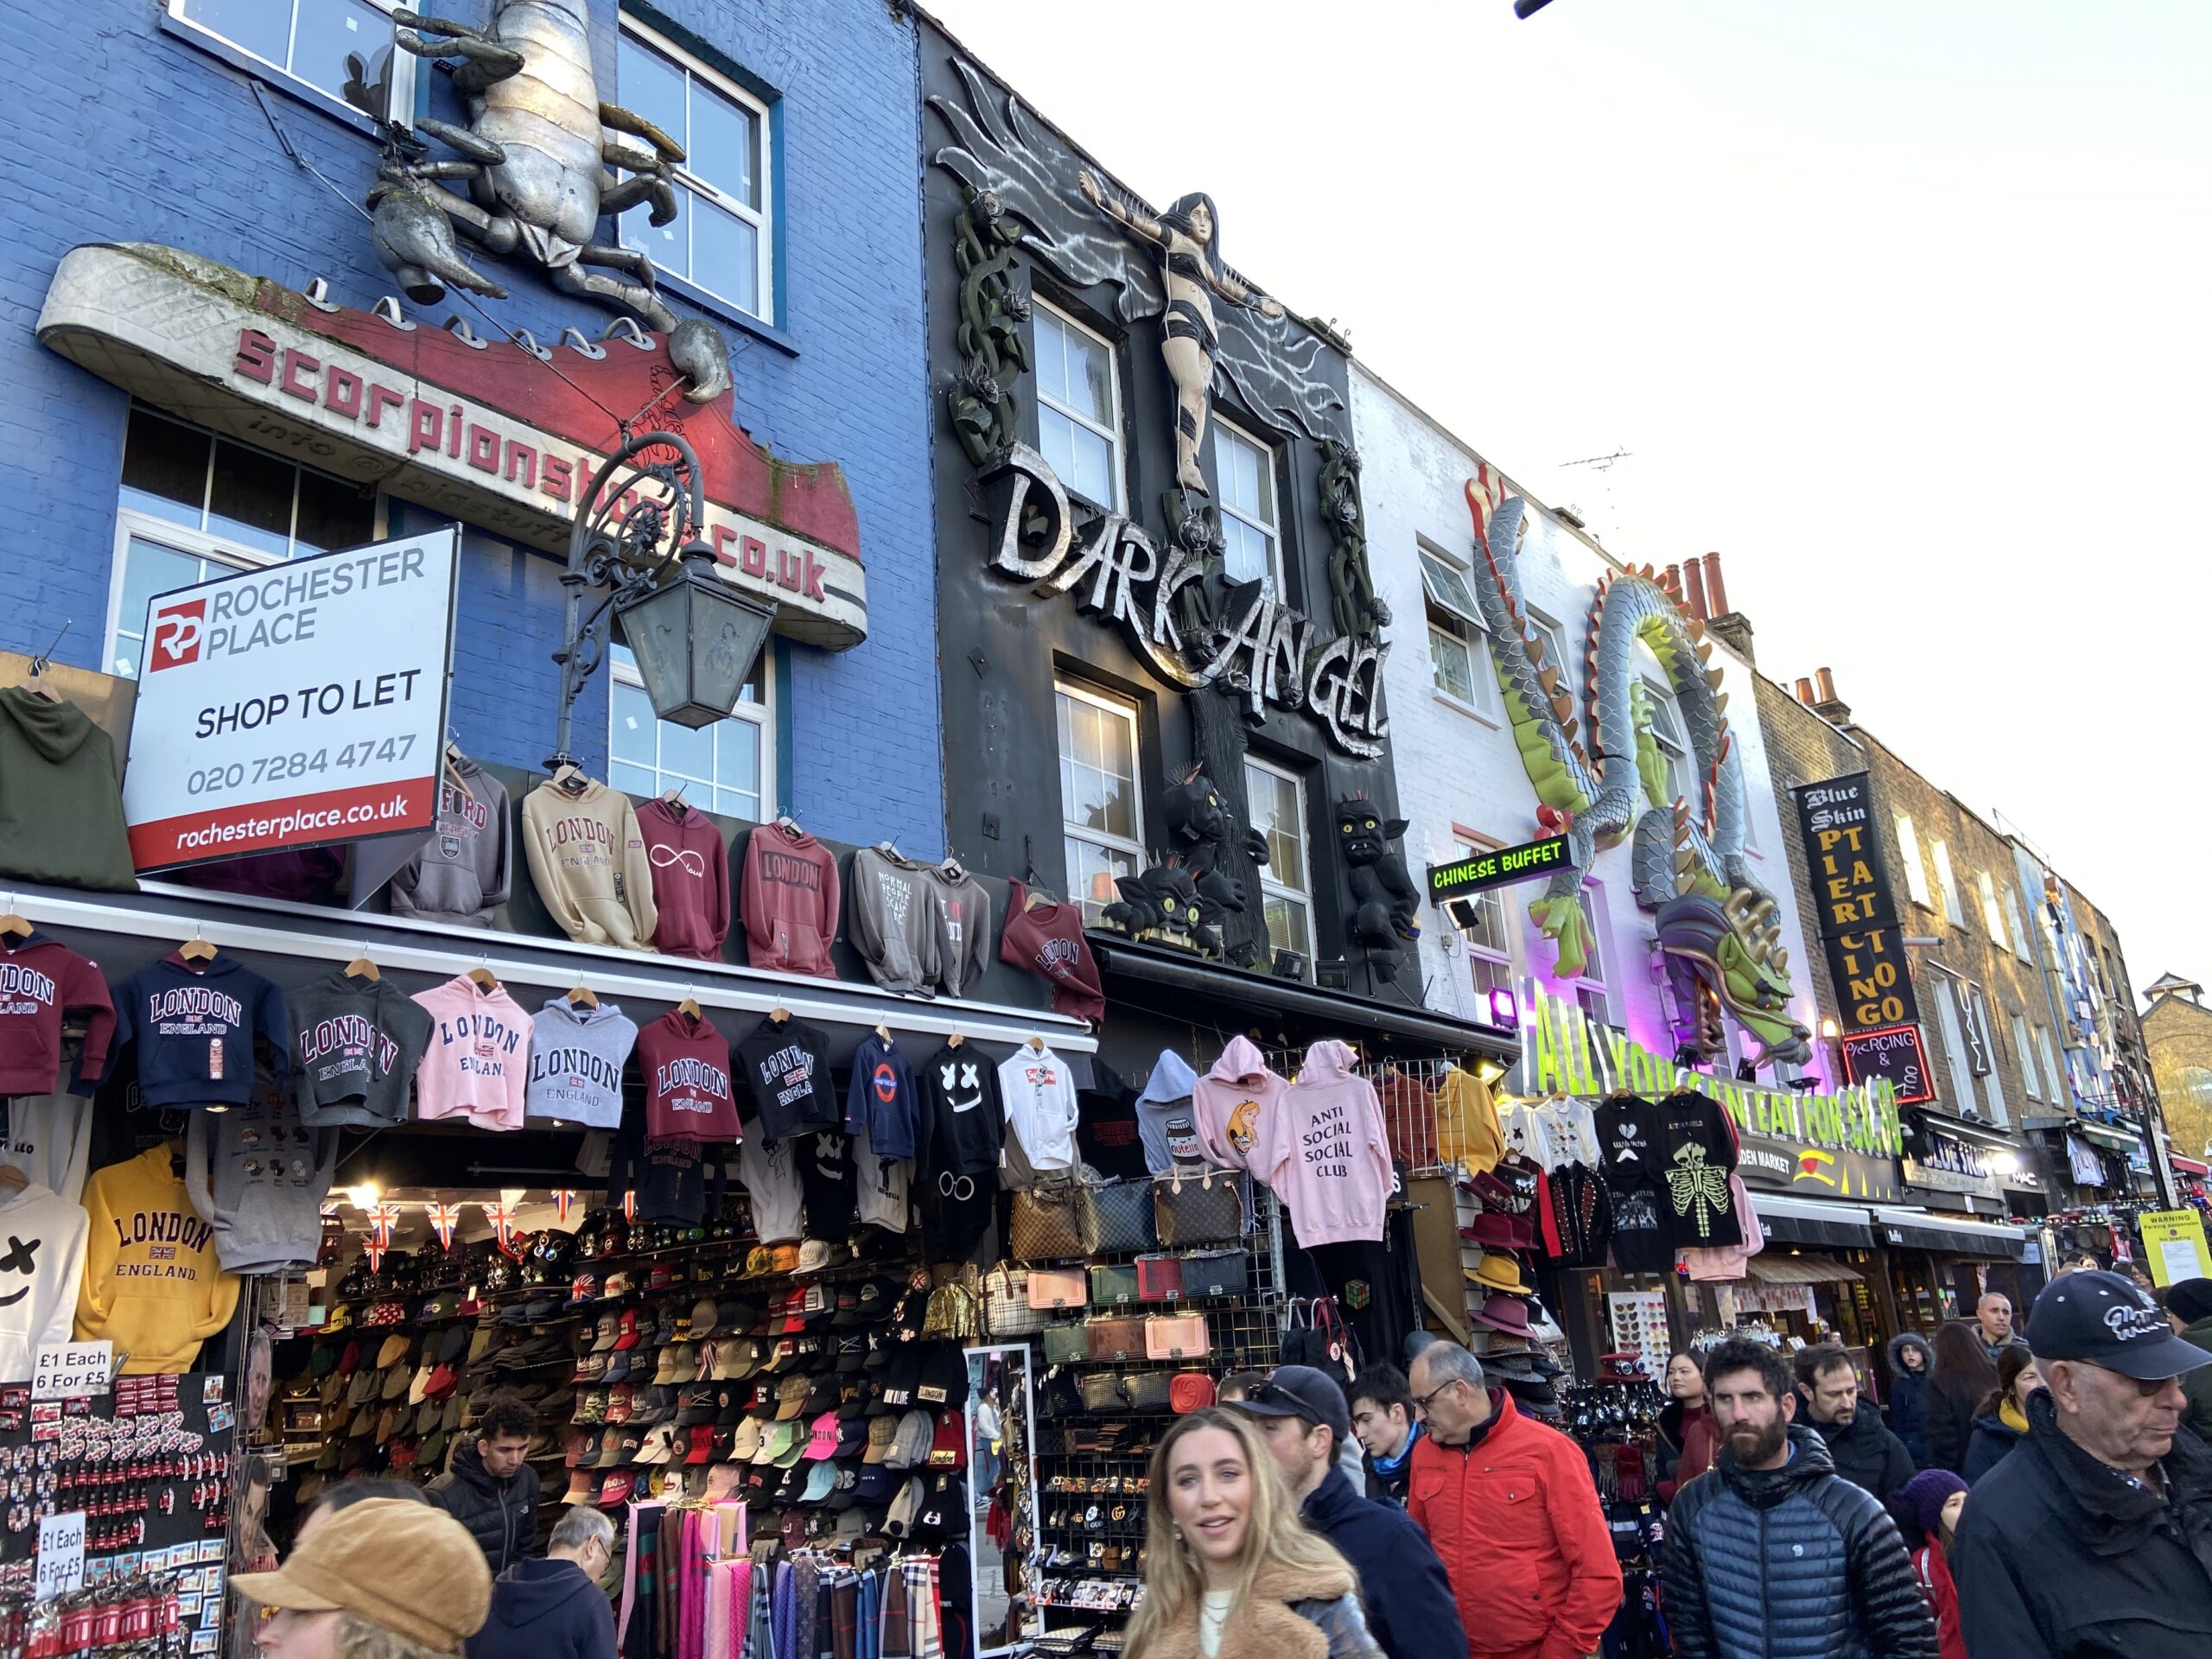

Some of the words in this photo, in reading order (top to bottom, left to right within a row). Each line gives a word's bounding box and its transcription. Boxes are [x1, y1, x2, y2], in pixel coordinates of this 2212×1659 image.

[982, 441, 1208, 688] DARK
[212, 548, 425, 623] ROCHESTER
[207, 607, 317, 660] PLACE
[195, 694, 289, 739] SHOP
[298, 683, 344, 718] TO
[353, 670, 421, 709] LET
[188, 764, 244, 795] 020
[251, 749, 327, 784] 7284
[336, 734, 416, 768] 4747
[442, 787, 486, 830] FORD
[1804, 785, 1859, 810] Blue
[176, 795, 408, 849] rochesterplace.co.uk
[1810, 805, 1866, 833] Skin
[546, 817, 614, 855] LONDON
[561, 855, 611, 868] ENGLAND
[765, 852, 819, 889] LONDON
[1434, 859, 1497, 888] CHINESE
[1502, 842, 1561, 872] BUFFET
[878, 872, 912, 895] NORMAL
[881, 883, 911, 906] PEOPLE
[150, 988, 242, 1027] LONDON
[159, 1023, 227, 1035] ENGLAND
[300, 1014, 398, 1076] LONDON
[531, 1047, 620, 1094] LONDON
[760, 1046, 814, 1085] LONDN
[1528, 977, 1599, 1096] ALL
[1599, 1022, 1676, 1104] YOU
[1752, 1090, 1797, 1136] EAT
[1802, 1093, 1847, 1149] FOR
[1878, 1052, 1891, 1065] &
[658, 1058, 728, 1101] LONDON
[546, 1088, 600, 1108] ENGLAND
[778, 1081, 813, 1106] ENGLA
[1311, 1106, 1344, 1127] ANTI
[1302, 1122, 1351, 1147] SOCIAL
[1305, 1141, 1353, 1163] SOCIAL
[1758, 1150, 1790, 1174] MARKET
[1316, 1165, 1347, 1178] CLUB
[2012, 1173, 2037, 1186] MAC
[2150, 1215, 2190, 1224] WARNING
[114, 1211, 215, 1255] LONDON
[115, 1264, 197, 1281] ENGLAND
[40, 1353, 60, 1367] £1
[66, 1351, 106, 1366] Each
[36, 1375, 47, 1389] 6
[52, 1373, 81, 1388] For
[86, 1370, 105, 1385] £5
[931, 1451, 954, 1464] London
[42, 1533, 56, 1552] £1
[57, 1530, 82, 1548] Each
[40, 1567, 47, 1584] 6
[48, 1564, 65, 1581] For
[66, 1560, 80, 1578] £5
